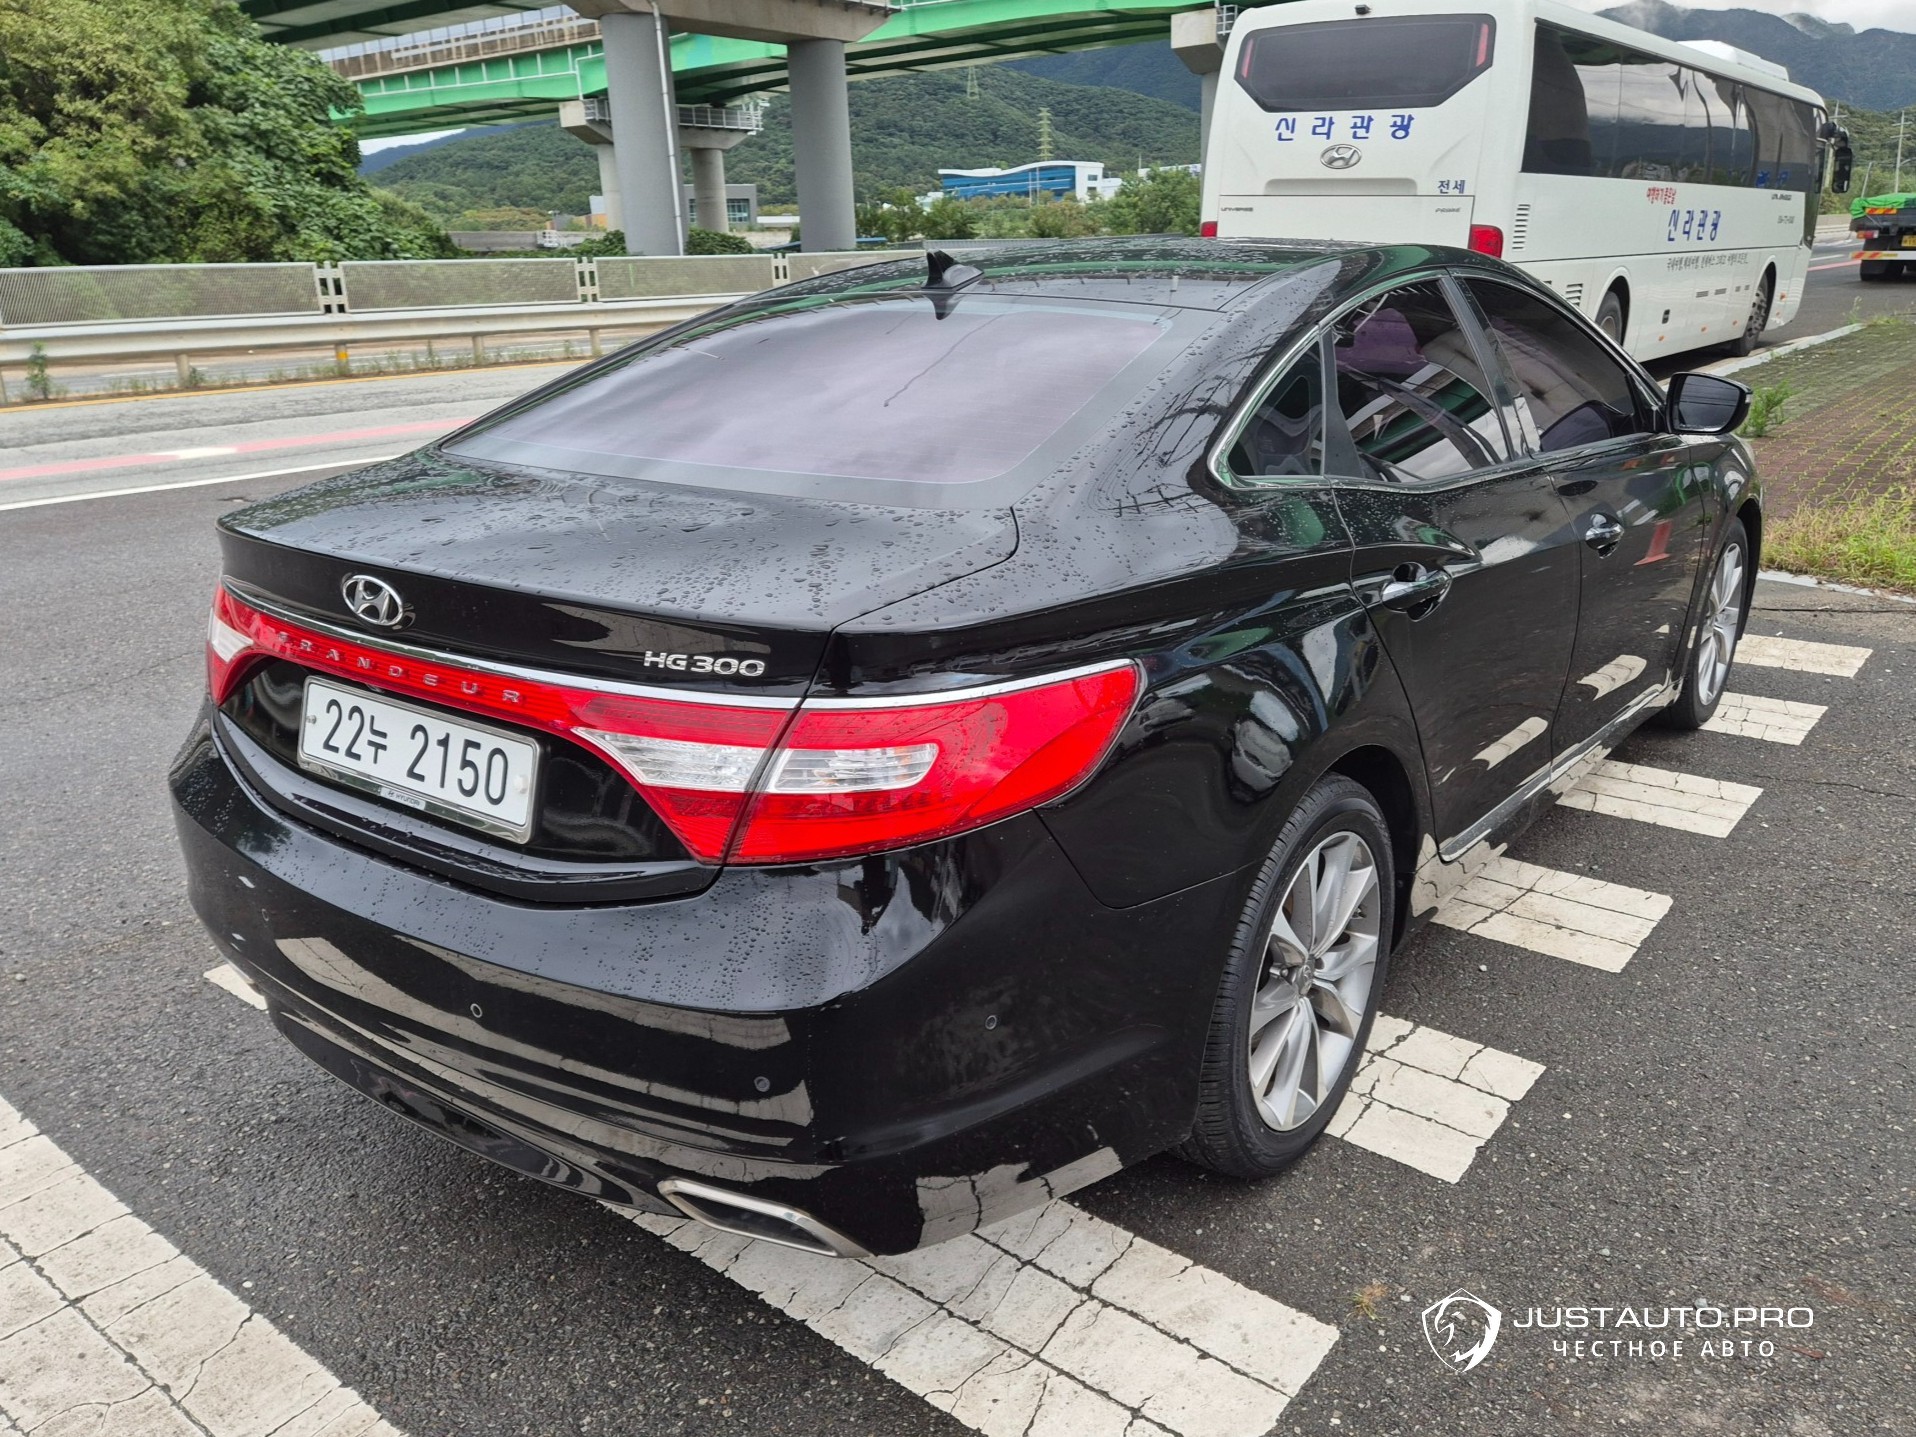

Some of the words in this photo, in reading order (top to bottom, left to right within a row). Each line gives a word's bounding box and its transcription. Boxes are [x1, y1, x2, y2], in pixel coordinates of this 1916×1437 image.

[1275, 114, 1415, 141] 신라관광
[1437, 179, 1466, 194] 전세
[1667, 209, 1721, 242] 신라관광
[277, 631, 521, 703] GRANDEUR
[643, 650, 766, 677] HG300
[322, 698, 388, 765] 22누
[406, 723, 509, 806] 2150
